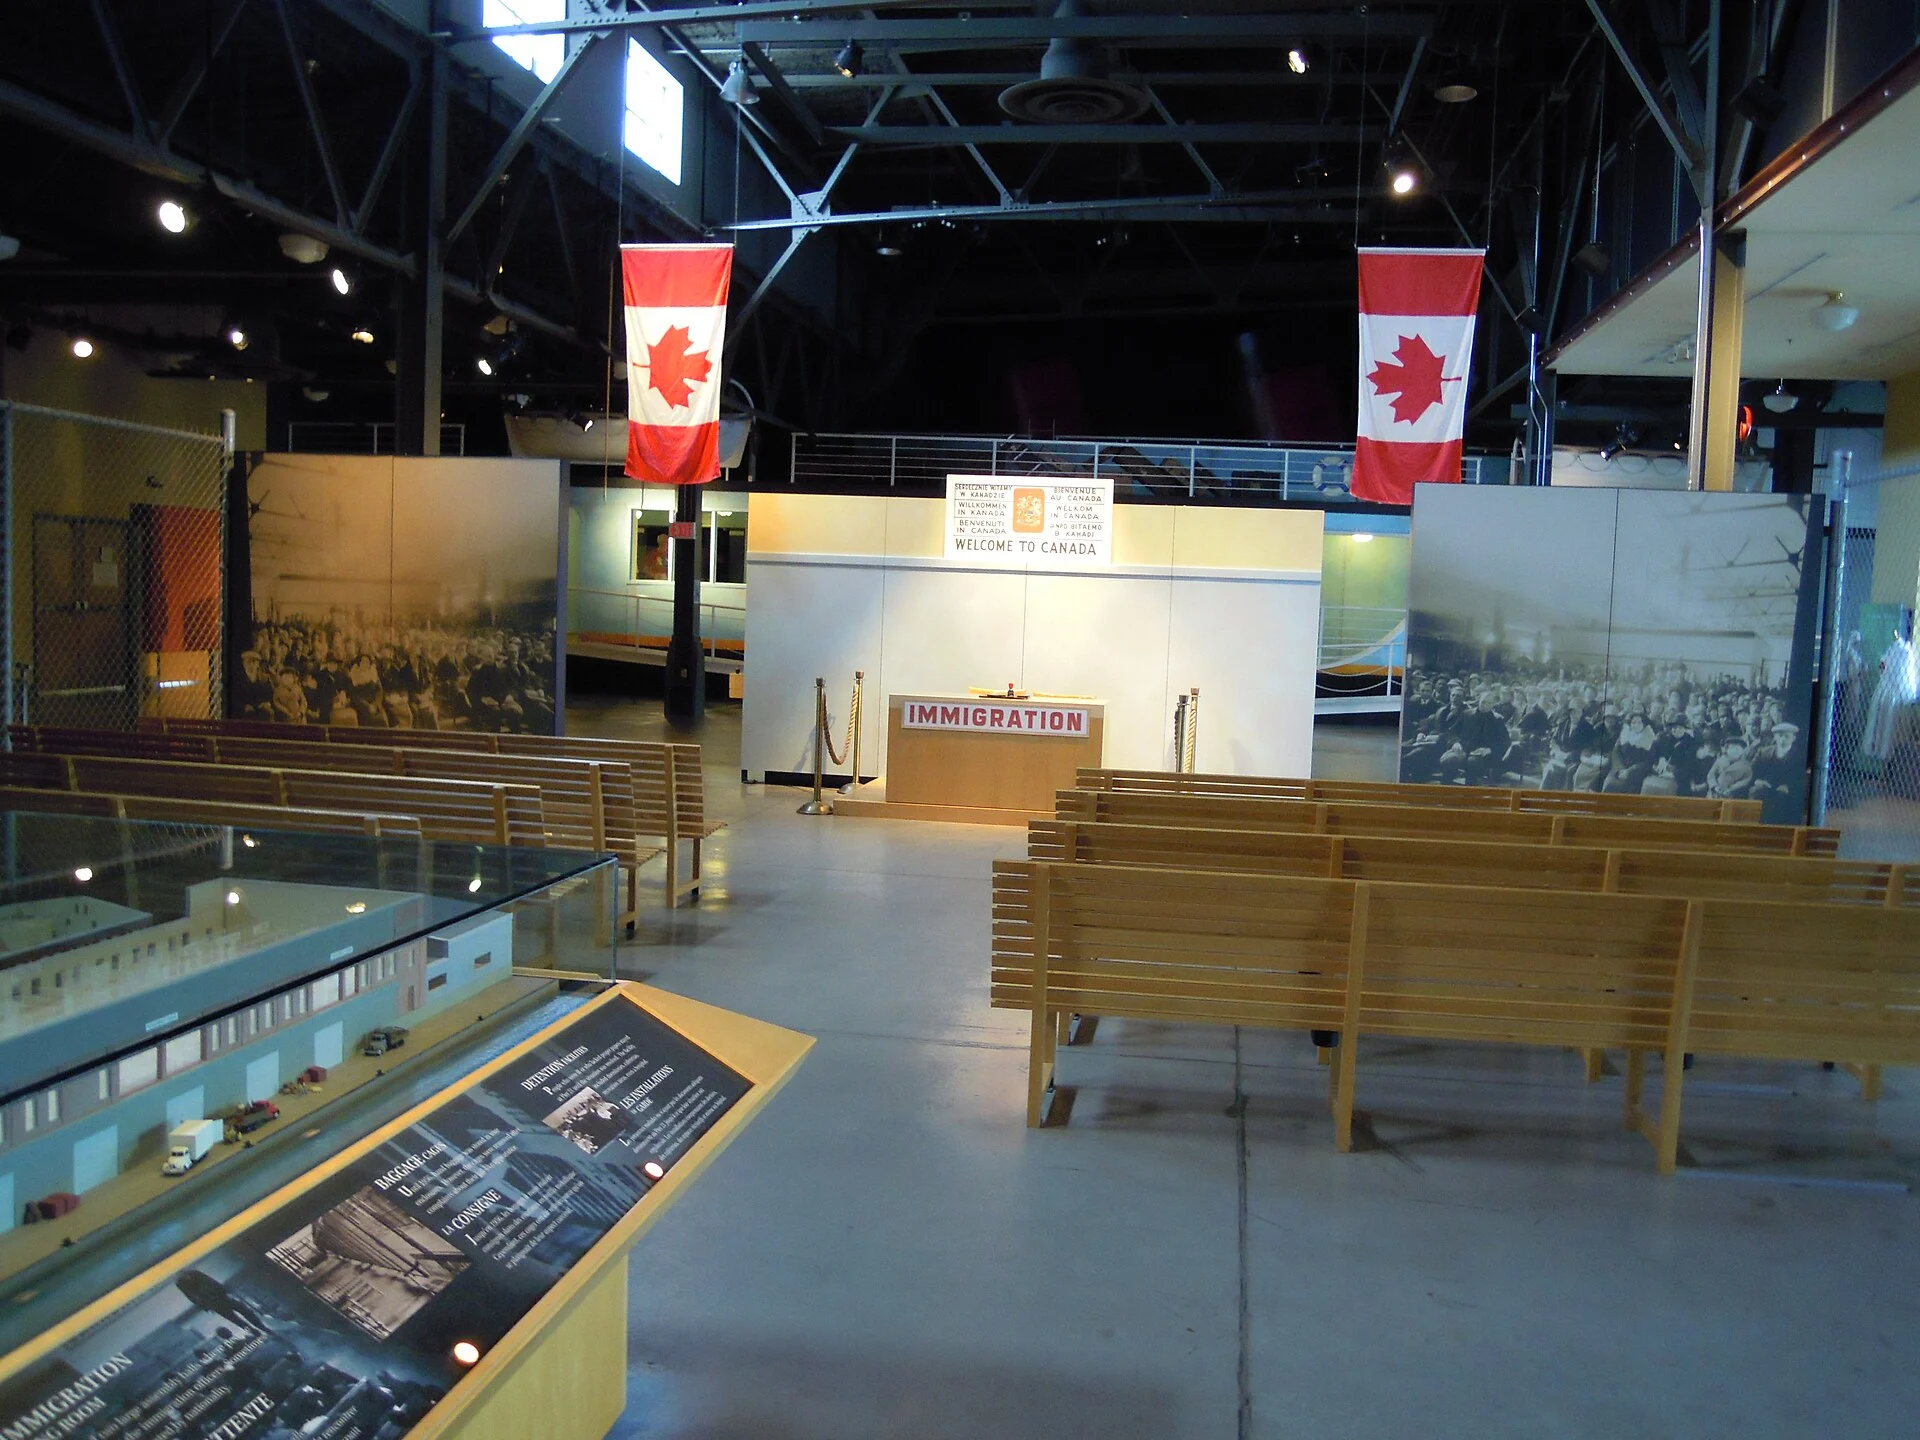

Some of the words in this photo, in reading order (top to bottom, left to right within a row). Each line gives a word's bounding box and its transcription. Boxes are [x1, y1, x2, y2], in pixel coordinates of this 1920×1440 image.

[970, 491, 1005, 499] KANADZIE
[1067, 494, 1102, 502] CANADA
[958, 501, 1007, 509] WILLKOMMEN
[959, 519, 1005, 527] BENVENUTI
[1063, 512, 1100, 520] CANADA
[970, 527, 1007, 535] CANADA
[955, 538, 1013, 552] WELCOME
[1018, 540, 1036, 553] TO
[1041, 541, 1097, 556] CANADA
[909, 704, 1082, 731] IMMIGRATION
[520, 1059, 564, 1091] DETENTION
[563, 1045, 589, 1066] FACILITIES
[619, 1094, 636, 1110] LES
[629, 1064, 674, 1101] INSTALLATIONS
[635, 1096, 654, 1113] GARDE
[374, 1153, 425, 1191] BAGGAGE
[424, 1141, 447, 1160] CAGES
[441, 1225, 456, 1236] LA
[452, 1188, 502, 1230] CONSIGNE
[57, 1395, 107, 1433] ROOM
[204, 1391, 275, 1440] TTENTE
